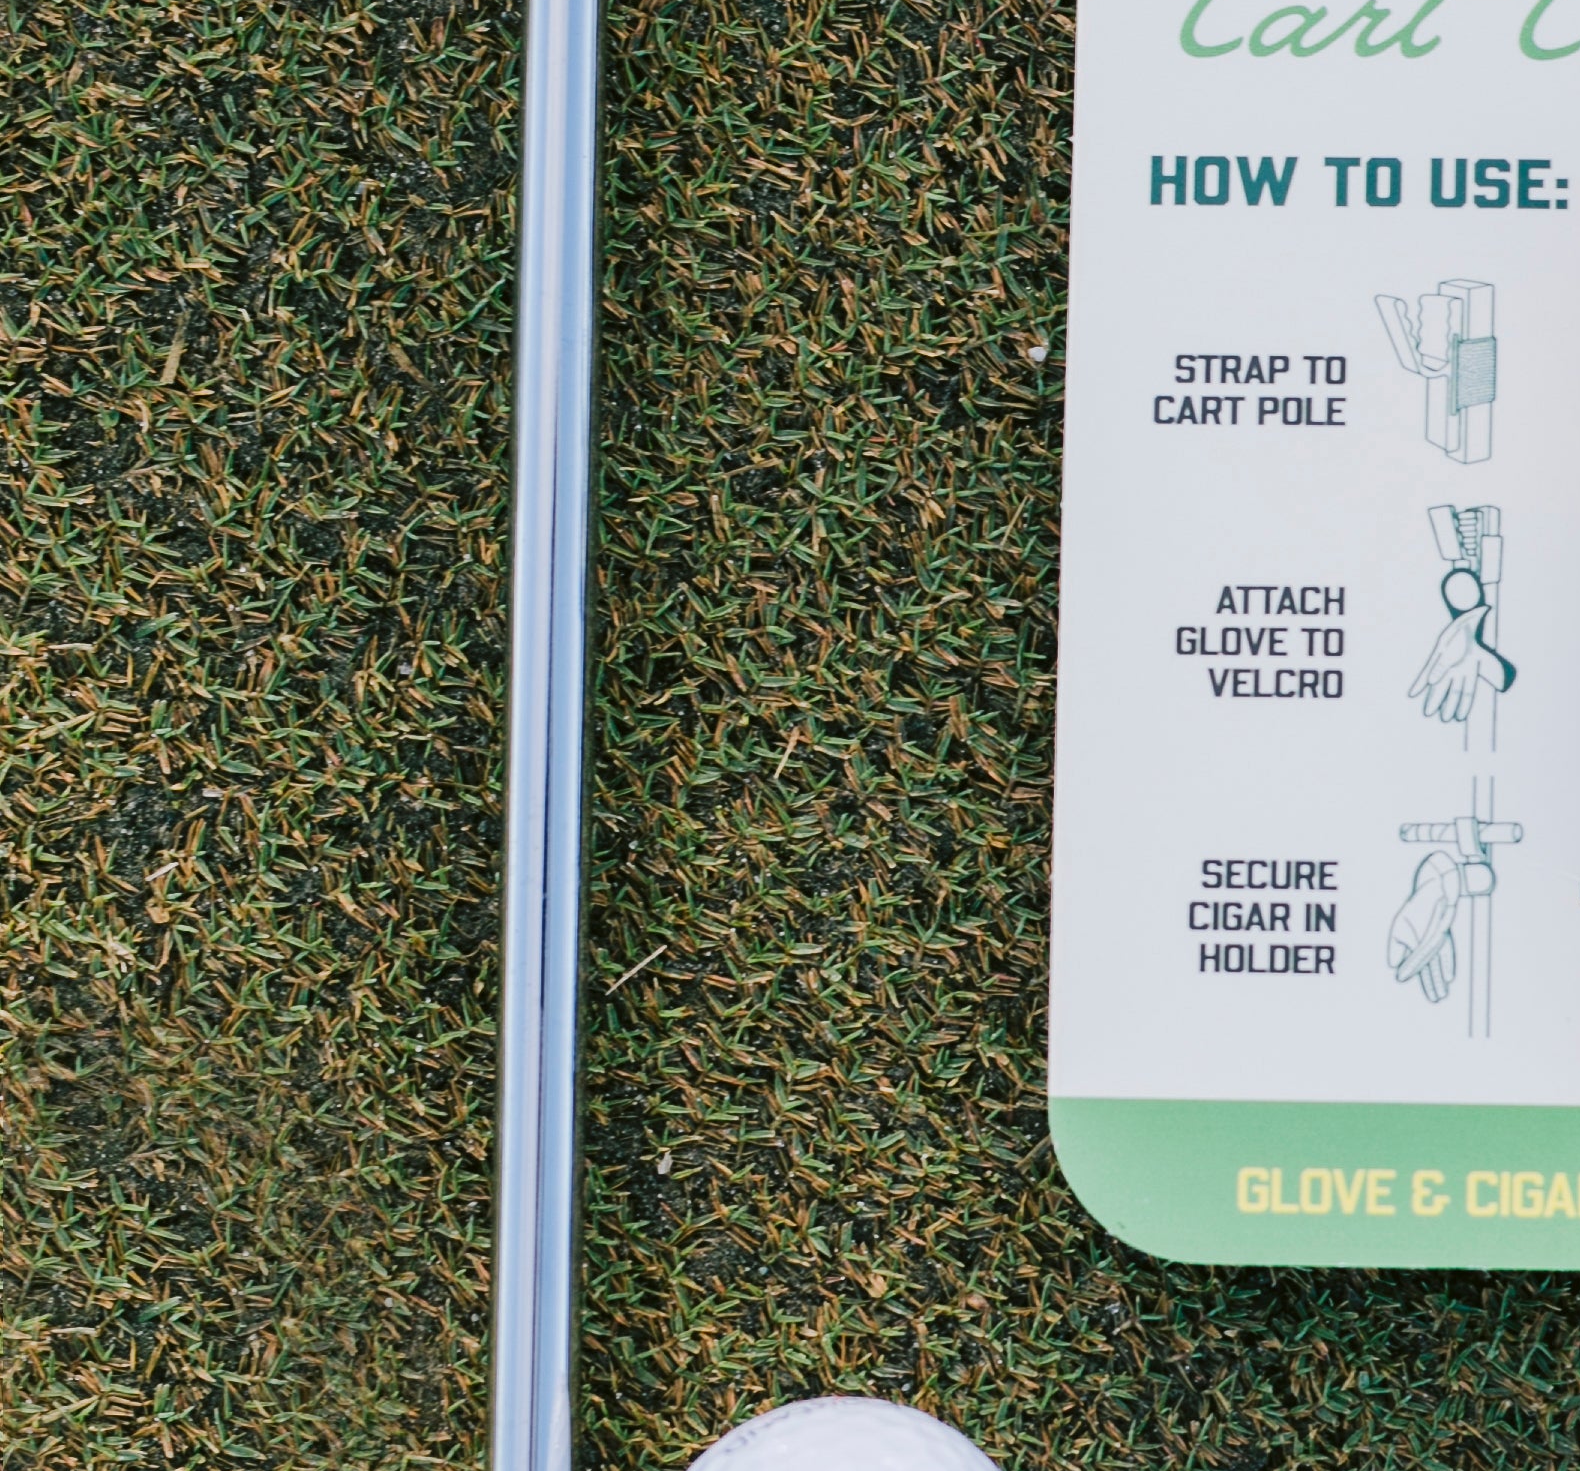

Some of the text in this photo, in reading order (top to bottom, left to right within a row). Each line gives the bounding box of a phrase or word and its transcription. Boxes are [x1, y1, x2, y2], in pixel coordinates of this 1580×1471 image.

[1150, 155, 1569, 210] HOW TO USE:
[1175, 354, 1347, 385] STRAP TO
[1153, 395, 1347, 426] CART POLE
[1215, 585, 1345, 616] ATTACH
[1176, 626, 1344, 657] GLOVE TO
[1208, 668, 1343, 699] VELCRO
[1201, 859, 1339, 891] SECURE
[1188, 901, 1337, 933] CIGAR IN
[1199, 943, 1335, 975] HOLDER
[1236, 1167, 1396, 1217] GLOVE
[1411, 1169, 1450, 1217] &
